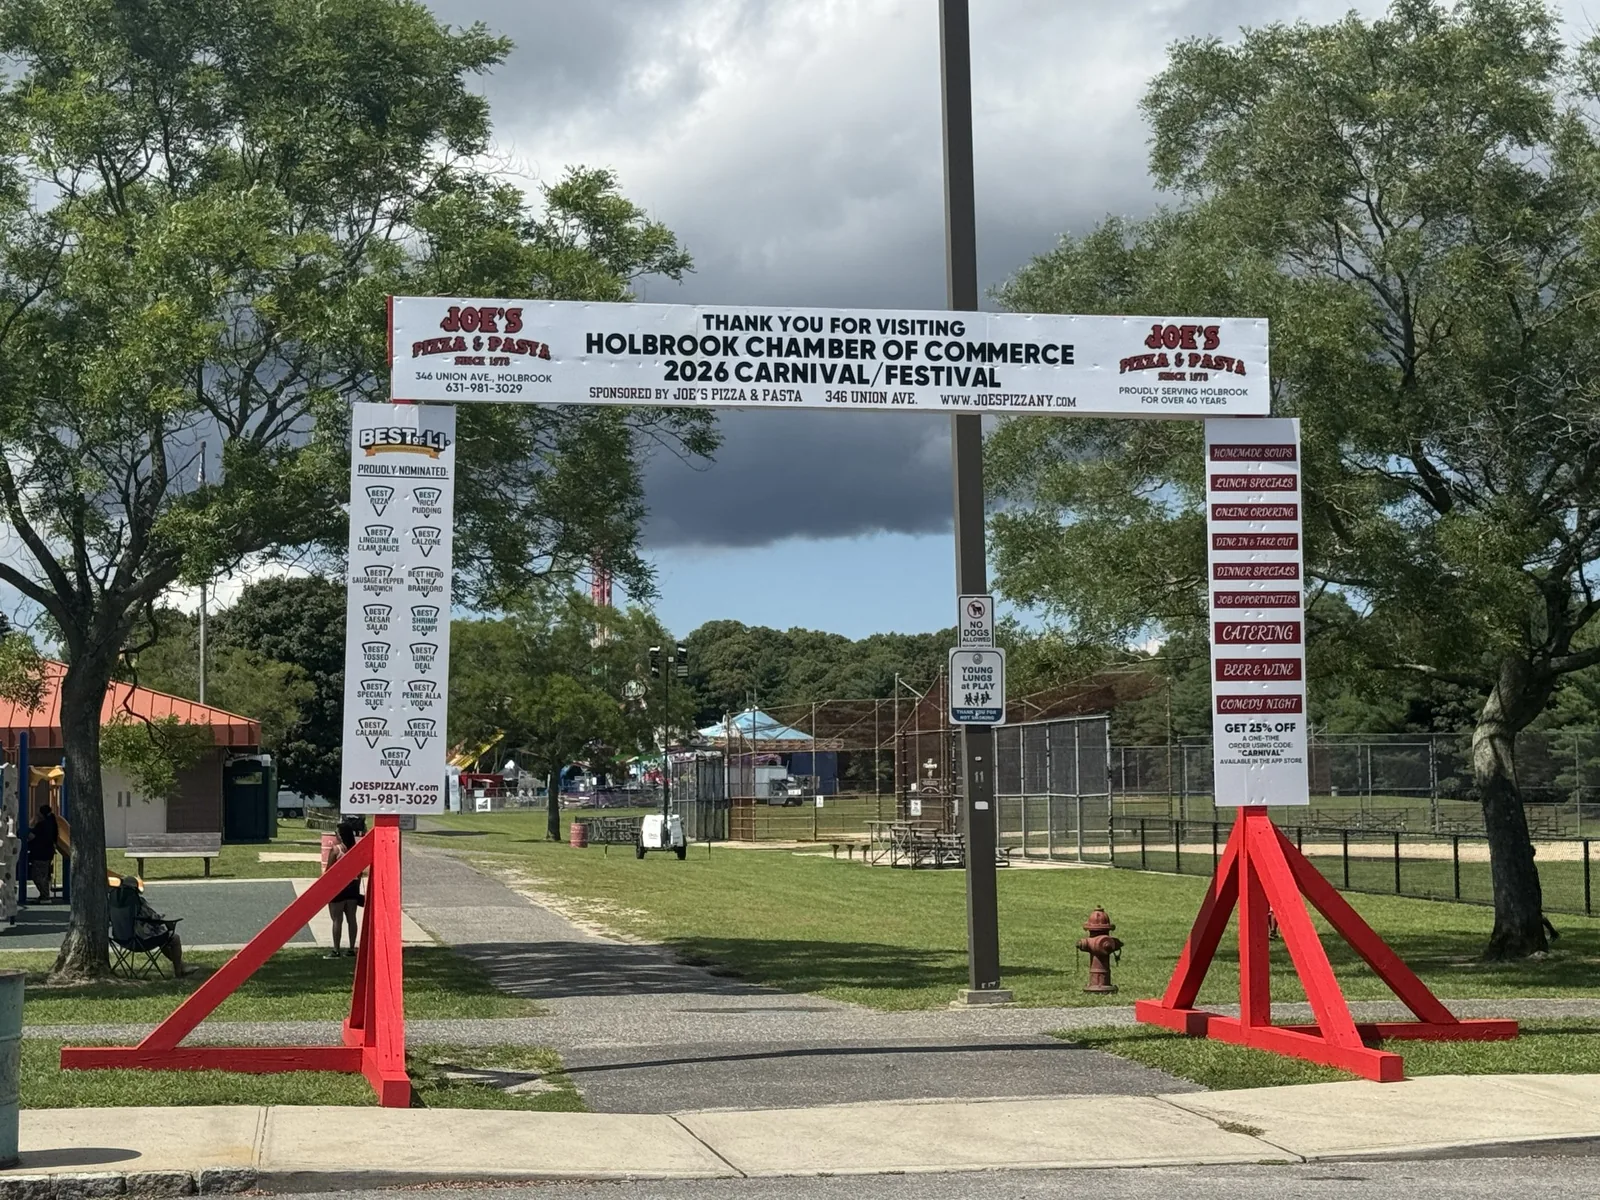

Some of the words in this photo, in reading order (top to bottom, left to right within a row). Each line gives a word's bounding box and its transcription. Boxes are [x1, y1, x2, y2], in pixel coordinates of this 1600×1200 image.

[441, 306, 523, 333] JOE'S
[703, 314, 772, 332] THANK
[778, 315, 823, 333] YOU
[830, 317, 872, 335] FOR
[876, 318, 965, 337] VISITING
[1144, 325, 1220, 350] JOE'S
[412, 336, 468, 358] PIZZA
[473, 335, 484, 351] &
[488, 336, 551, 360] PASTA
[586, 333, 740, 356] HOLBROOK
[745, 336, 876, 360] CHAMBER
[882, 340, 918, 361] OF
[924, 341, 1075, 365] COMMERCE
[1119, 353, 1170, 374] PIZZA
[1174, 353, 1185, 368] &
[1188, 353, 1247, 376] PASTA
[415, 372, 433, 380] 346
[436, 372, 467, 381] UNION
[498, 374, 552, 383] HOLBROOK
[664, 360, 729, 383] 2026
[734, 362, 1001, 388] CARNIVAL/FESTIVAL
[445, 383, 523, 393] 631-981-3029
[1119, 387, 1159, 395] PROUDLY
[1161, 387, 1198, 396] SERVING
[1200, 388, 1248, 396] HOLBROOK
[589, 387, 652, 399] SPONSORED
[655, 388, 670, 400] BY
[673, 388, 708, 400] JOE'S
[711, 389, 747, 401] PIZZA
[750, 389, 759, 401] &
[762, 389, 803, 402] PASTA
[825, 391, 847, 403] 346
[851, 392, 887, 404] UNION
[891, 392, 918, 405] AVE.
[940, 393, 1076, 407] WWW.JOESPIZZANY.COM
[1186, 397, 1198, 405] 40
[1199, 397, 1227, 405] YEARS
[360, 427, 417, 449] BEST
[1214, 447, 1262, 458] HOMEMADE
[1263, 448, 1292, 458] SOUPS
[358, 464, 397, 474] PROUDLY
[399, 466, 449, 476] NOMINATED:
[1215, 477, 1247, 488] LUNCH
[1249, 477, 1294, 488] SPECIALS
[1215, 507, 1249, 517] ONLINE
[1250, 507, 1294, 517] ORDERING
[1216, 536, 1236, 546] DINE
[1238, 536, 1248, 546] IN
[1256, 537, 1275, 546] TAKE
[1276, 536, 1294, 546] OUT
[1217, 566, 1251, 576] DINNER
[1253, 566, 1295, 576] SPECIALS
[1217, 595, 1233, 604] JOB
[1234, 594, 1297, 604] OPPORTUNITIES
[963, 629, 990, 637] DOGS
[1222, 625, 1293, 641] CATERING
[961, 666, 993, 674] YOUNG
[1224, 664, 1251, 676] BEER
[1253, 665, 1261, 675] &
[1262, 663, 1294, 676] WINE
[962, 674, 993, 682] LUNGS
[1220, 698, 1264, 710] COMEDY
[1266, 698, 1298, 709] NIGHT
[1224, 723, 1247, 733] GET
[1249, 723, 1272, 732] 25%
[1274, 722, 1296, 732] OFF
[974, 771, 984, 783] 11
[349, 781, 439, 792] JOESPIZZANY.com
[349, 794, 438, 805] 631-981-3029
